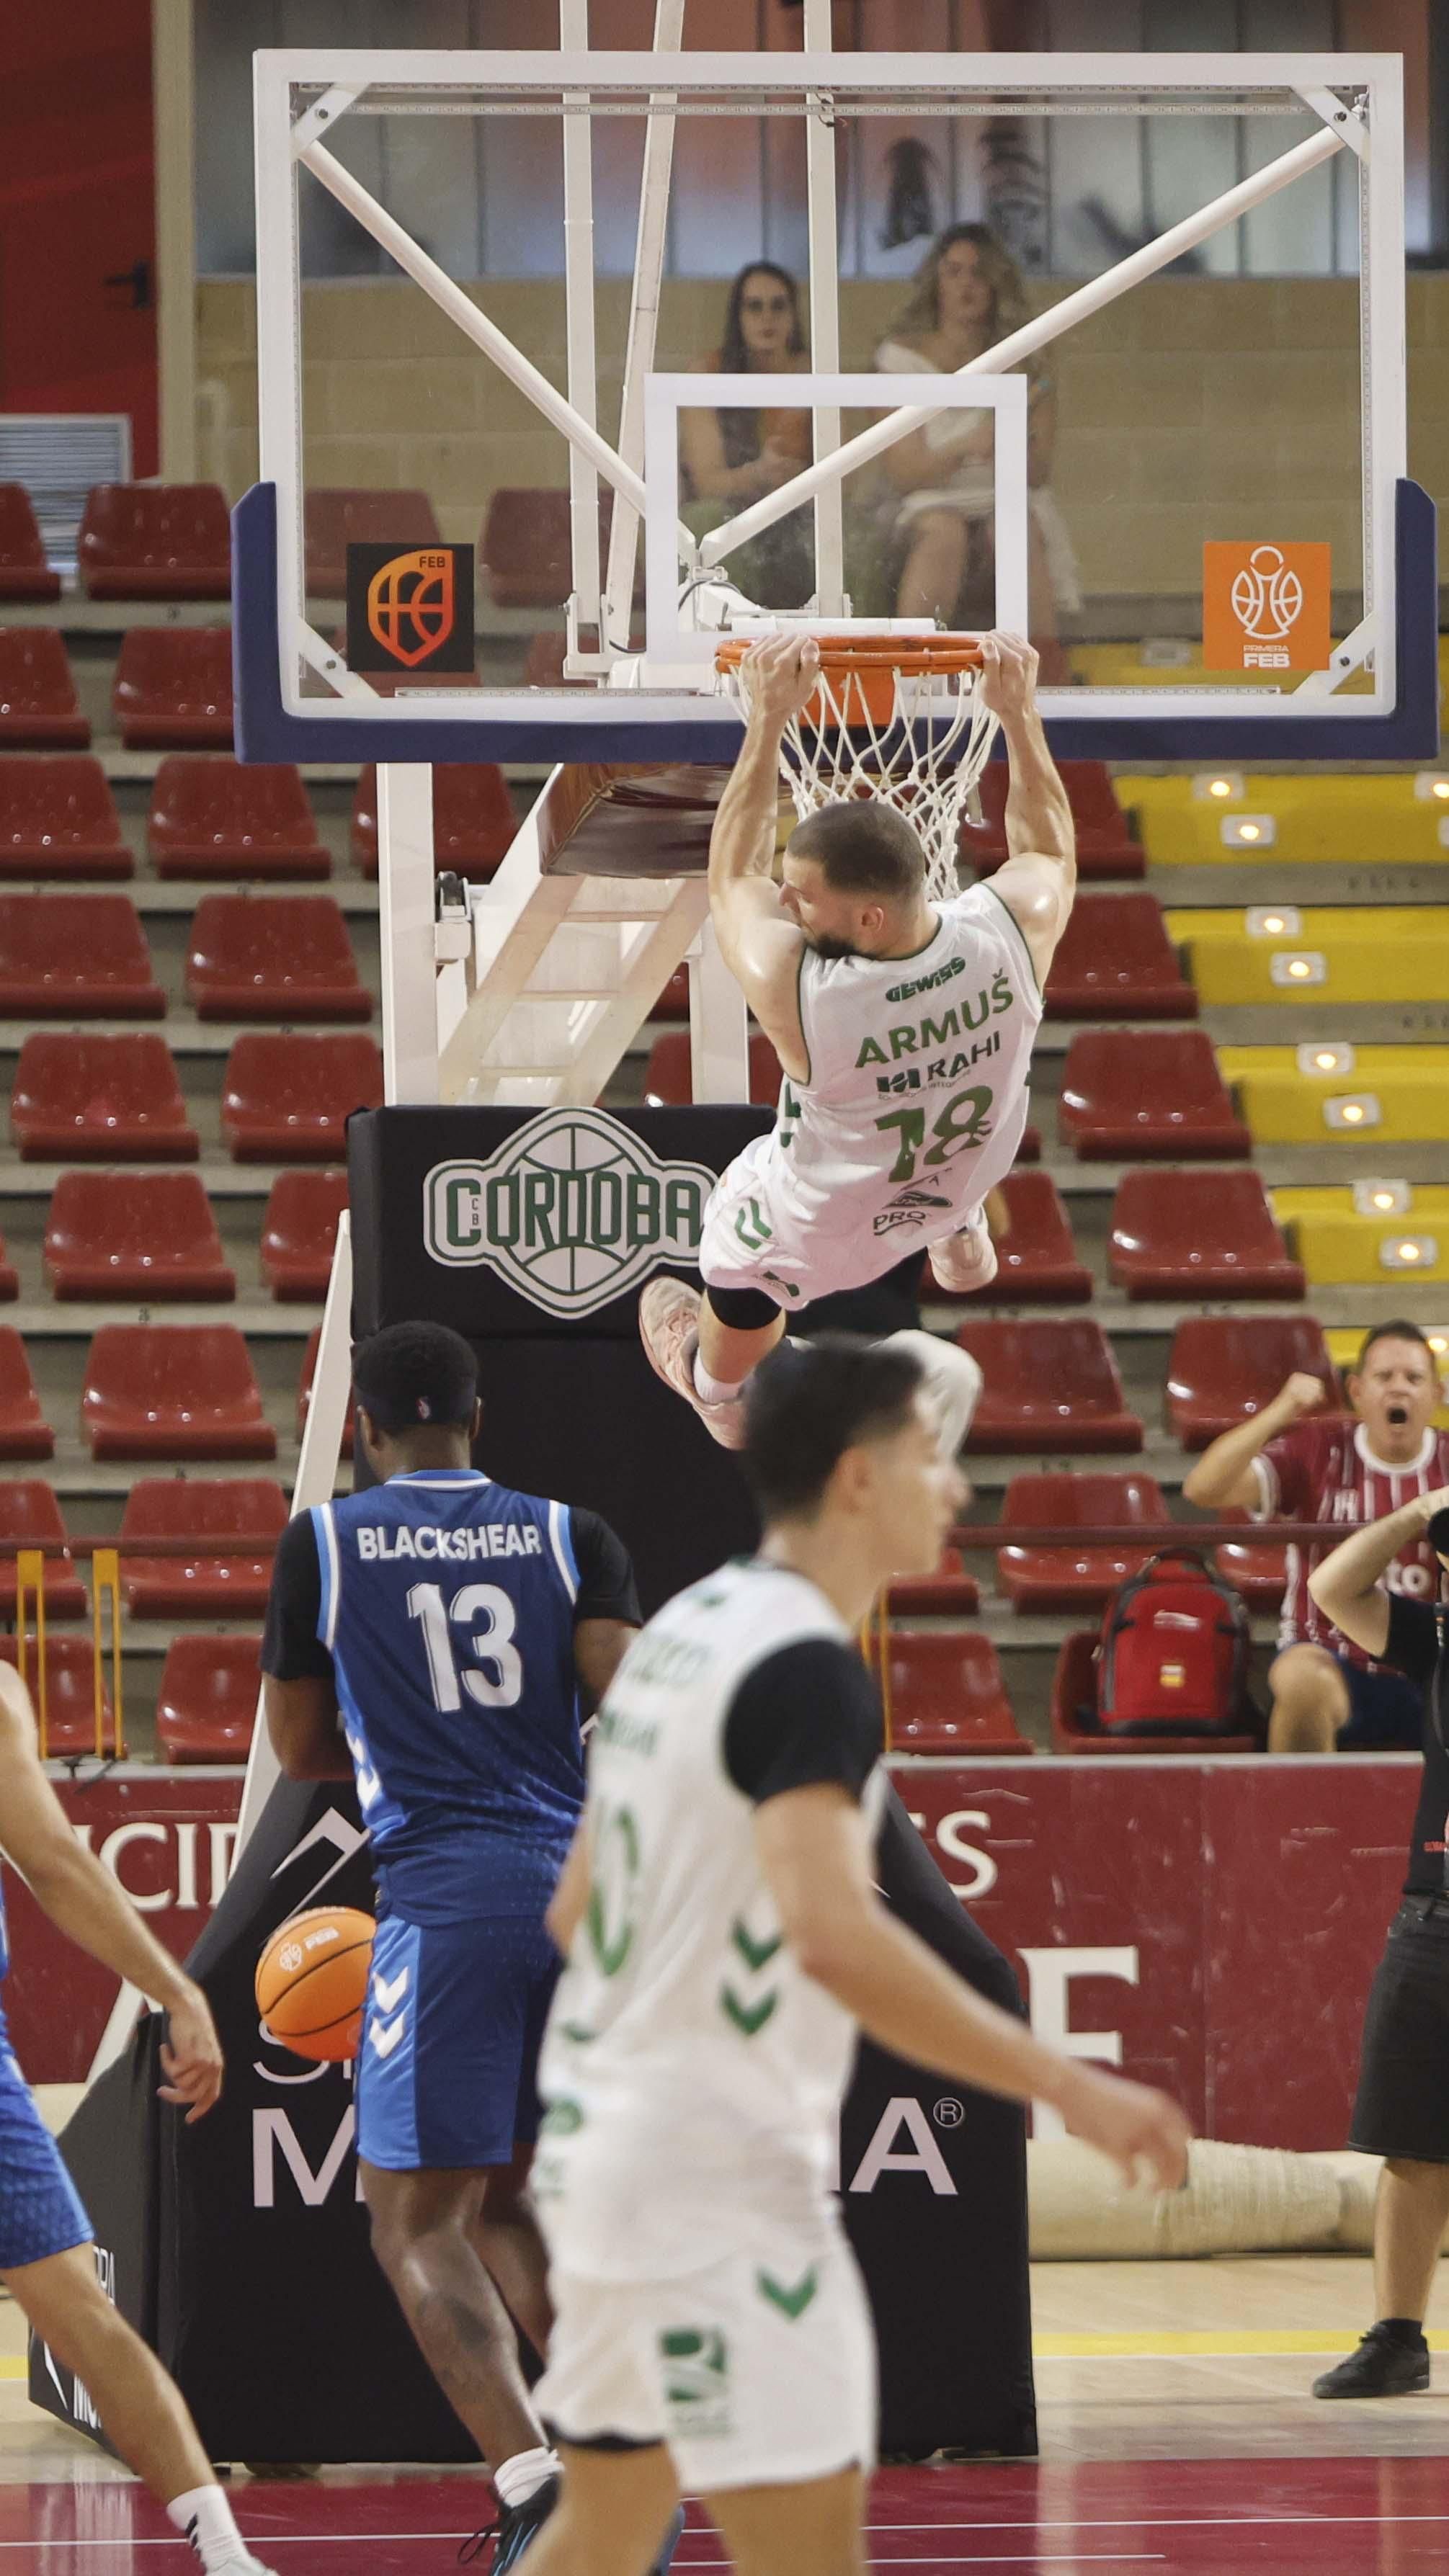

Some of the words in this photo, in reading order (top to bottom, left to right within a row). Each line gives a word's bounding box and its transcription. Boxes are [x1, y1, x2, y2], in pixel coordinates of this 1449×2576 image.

[419, 556, 445, 568] FEB
[1243, 653, 1290, 668] FEB
[854, 967, 1014, 1068] ARMUŠ
[927, 1030, 1001, 1081] RAHI
[357, 1524, 543, 1561] BLACKSHEAR
[406, 1583, 523, 1714] 13
